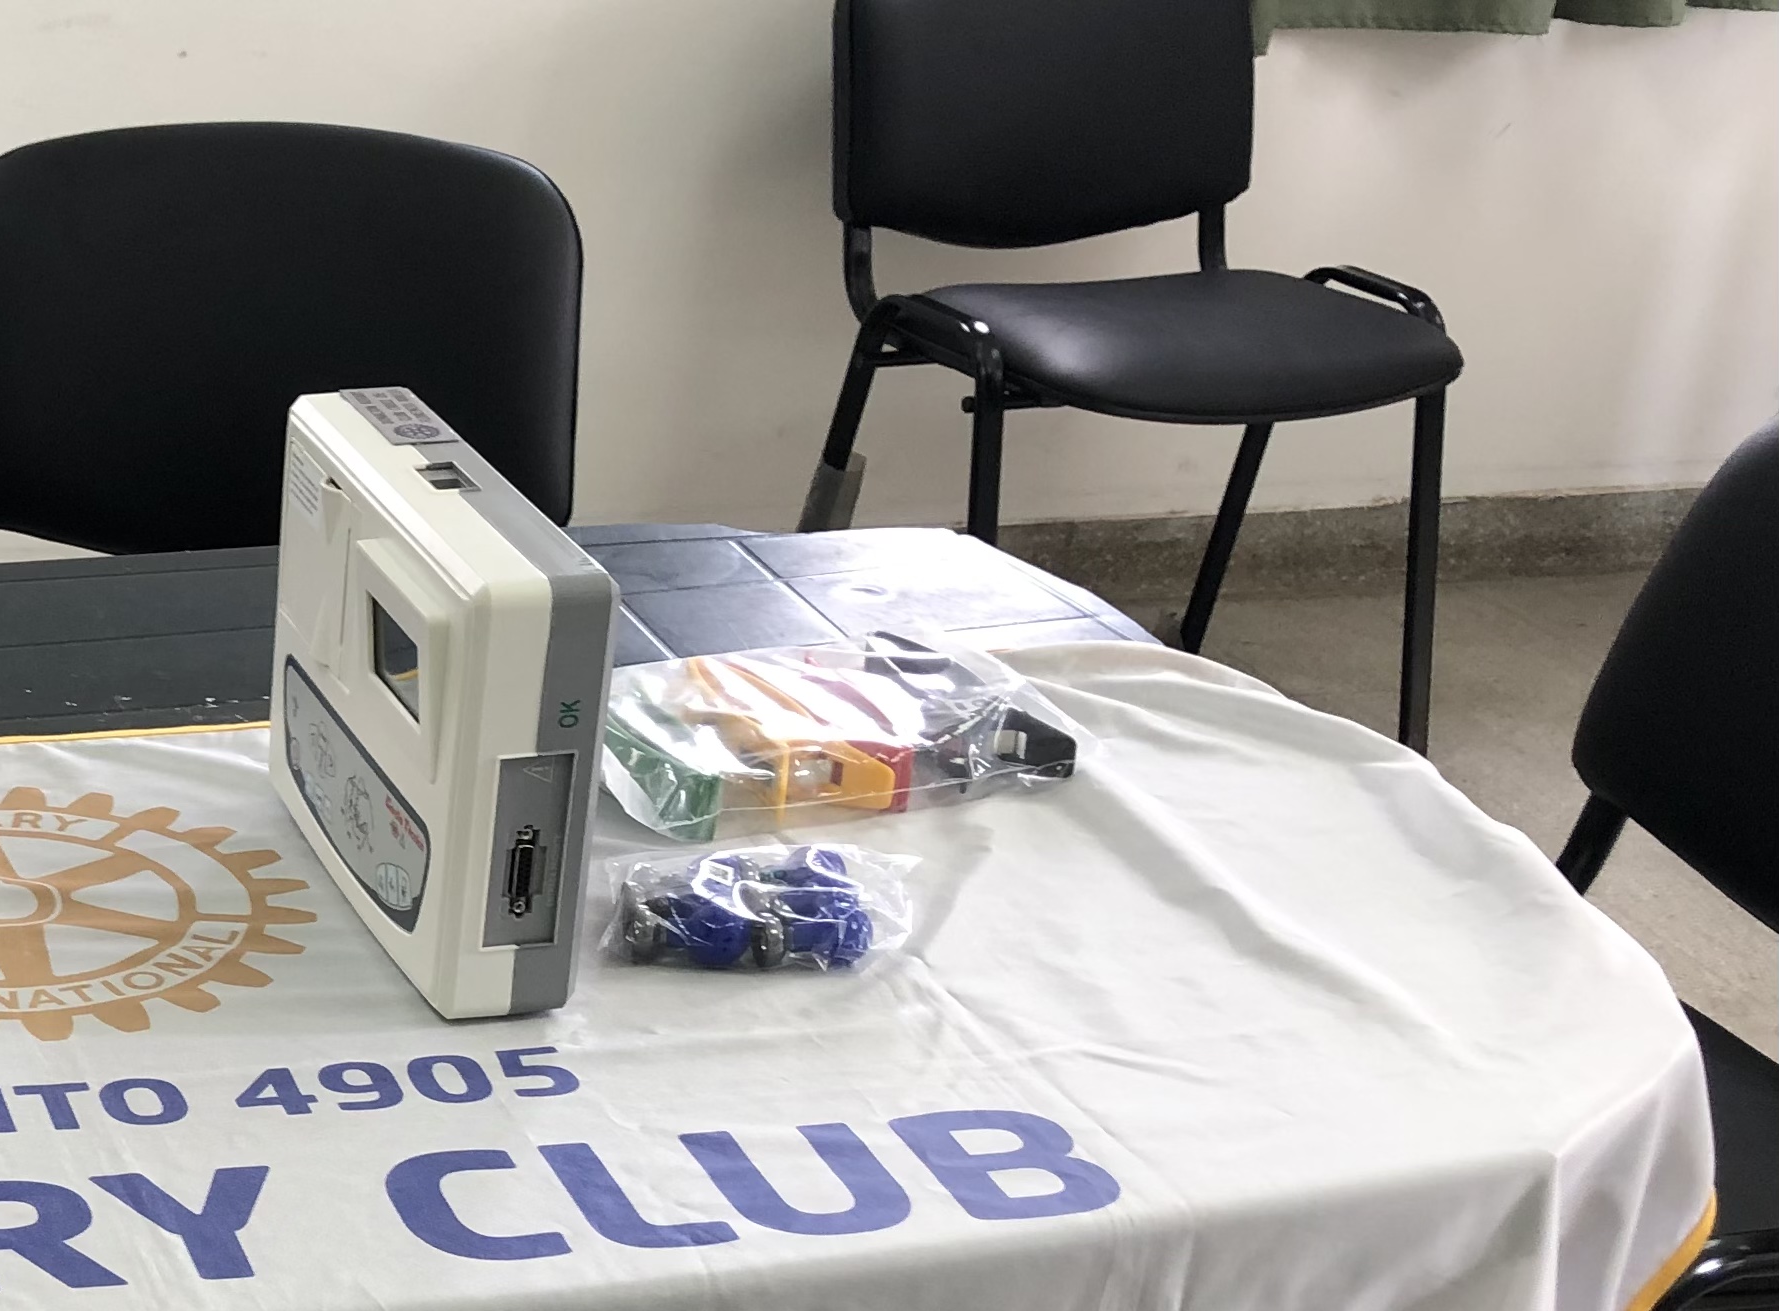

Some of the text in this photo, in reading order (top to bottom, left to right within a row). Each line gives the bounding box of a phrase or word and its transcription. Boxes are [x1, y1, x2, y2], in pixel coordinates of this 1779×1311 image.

[556, 698, 581, 729] OK
[235, 1045, 583, 1117] 4905
[384, 1109, 1121, 1262] CLUB
